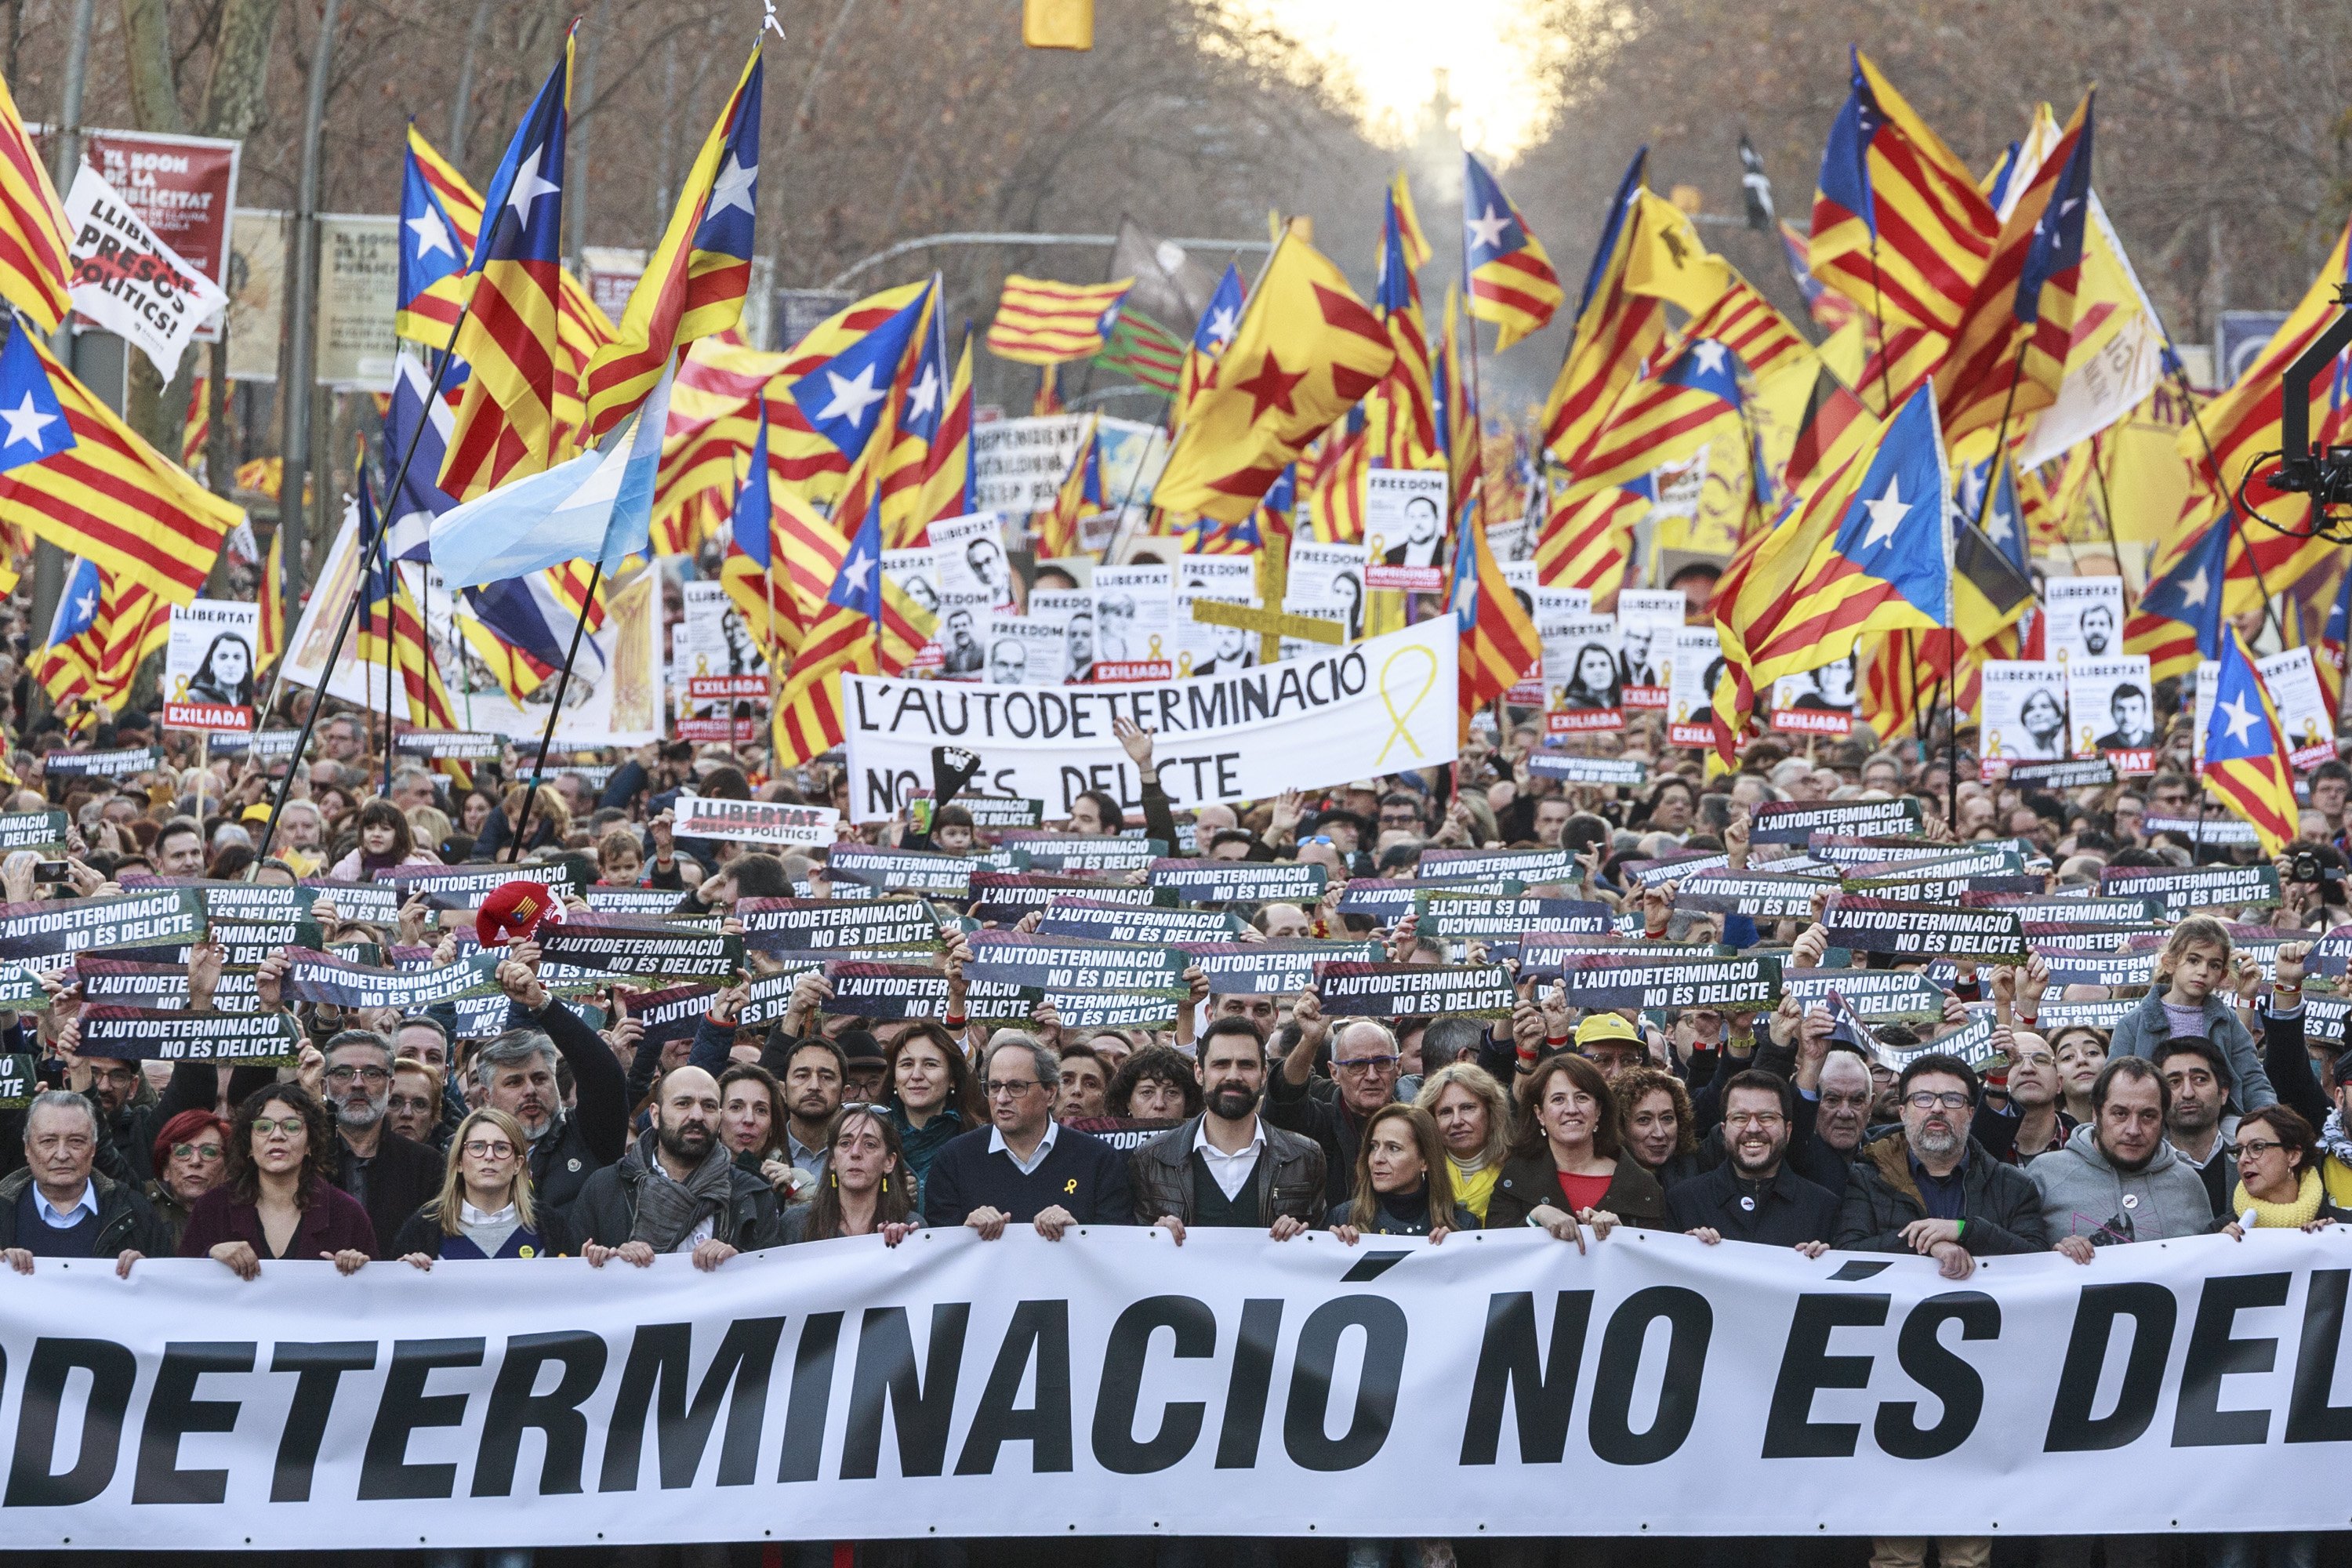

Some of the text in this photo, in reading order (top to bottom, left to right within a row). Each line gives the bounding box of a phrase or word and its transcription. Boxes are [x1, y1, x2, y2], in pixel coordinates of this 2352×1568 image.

[130, 151, 189, 174] BOOM
[116, 186, 213, 209] UBLICITAT
[1370, 477, 1443, 490] FREEDOM
[1182, 564, 1249, 575] FREEDOM
[2049, 585, 2118, 601] LLIBERTAT
[175, 609, 255, 624] LLIBERTAT
[1985, 670, 2063, 683] LLIBERTAT
[2072, 664, 2145, 677] LLIBERTAT
[855, 644, 1367, 739] L'AUTODETERMINACIÓ
[169, 707, 246, 725] EXILIADA
[1551, 713, 1624, 730] EXILIADA
[1776, 712, 1849, 732] EXILIADA
[1060, 751, 1242, 813] DELCTE
[692, 800, 820, 827] LLIBERTAT
[1758, 803, 1904, 830] L'AUTODETERMINACIÓ
[3, 829, 56, 847] DELICTE
[750, 824, 818, 842] POLÍTICS!
[1858, 818, 1914, 837] DELICTE
[833, 853, 978, 873] L'AUTODETERMINACIÓ
[1063, 856, 1080, 869] NO
[1099, 855, 1157, 869] DELICTE
[1422, 850, 1567, 878] L'AUTODETERMINACIÓ
[885, 871, 905, 887] NO
[907, 871, 924, 888] ÉS
[1154, 864, 1311, 885] L'AUTODETERMINACIÓ
[2107, 866, 2259, 895] L'AUTODETERMINACIÓ
[1213, 883, 1318, 900] NO ÉS DELICTE
[2167, 884, 2270, 908] NO ÉS DELICTE
[336, 905, 376, 921] NO ÉS
[1737, 895, 1784, 915] NO ÉS
[0, 894, 180, 939] 'AUTODETERMINACIÓ
[742, 901, 923, 931] L'AUTODETERMINACIÓ
[1046, 907, 1225, 928] L'AUTODETERMINACIÓ
[1828, 910, 2013, 933] L'AUTODETERMINACIÓ
[65, 928, 93, 951] NO
[94, 921, 117, 947] ÉS
[119, 913, 193, 943] DELICTE
[810, 923, 934, 947] NO ÉS DELICTE
[1109, 926, 1233, 942] NO ÉS DELICTE
[1895, 931, 2021, 953] NO ÉS DELICTE
[544, 936, 724, 956] L'AUTODETERMINACIÓ
[607, 953, 732, 975] NO ÉS DELICTE
[978, 946, 1166, 968] L'AUTODETERMINACIÓ
[294, 960, 470, 990] L'AUTODETERMINACIÓ
[1046, 967, 1175, 988] NO ÉS DELICTE
[1254, 970, 1305, 992] NO ÉS
[1324, 964, 1501, 996] L'AUTODETERMINACIÓ
[1573, 961, 1759, 989] L'AUTODETERMINACIÓ
[2100, 968, 2150, 985] NO ÉS
[361, 992, 385, 1007] NO
[388, 986, 411, 1005] ÉS
[414, 970, 484, 1002] DELICTE
[1642, 981, 1769, 1007] NO ÉS DELICTE
[905, 1000, 930, 1018] NO
[1391, 990, 1513, 1014] NO ÉS DELICTE
[1859, 993, 1931, 1013] DELICTE
[88, 1012, 280, 1038] L'AUTODETERMINACIÓ
[1083, 1006, 1105, 1025] ÉS
[1109, 1004, 1178, 1024] DELICTE
[2046, 1017, 2069, 1028] NO
[160, 1036, 290, 1058] NO ÉS DELICTE
[0, 1249, 1415, 1508] DETERMINACIÓ
[1458, 1284, 1715, 1467] NO
[1760, 1259, 2002, 1461] ÉS
